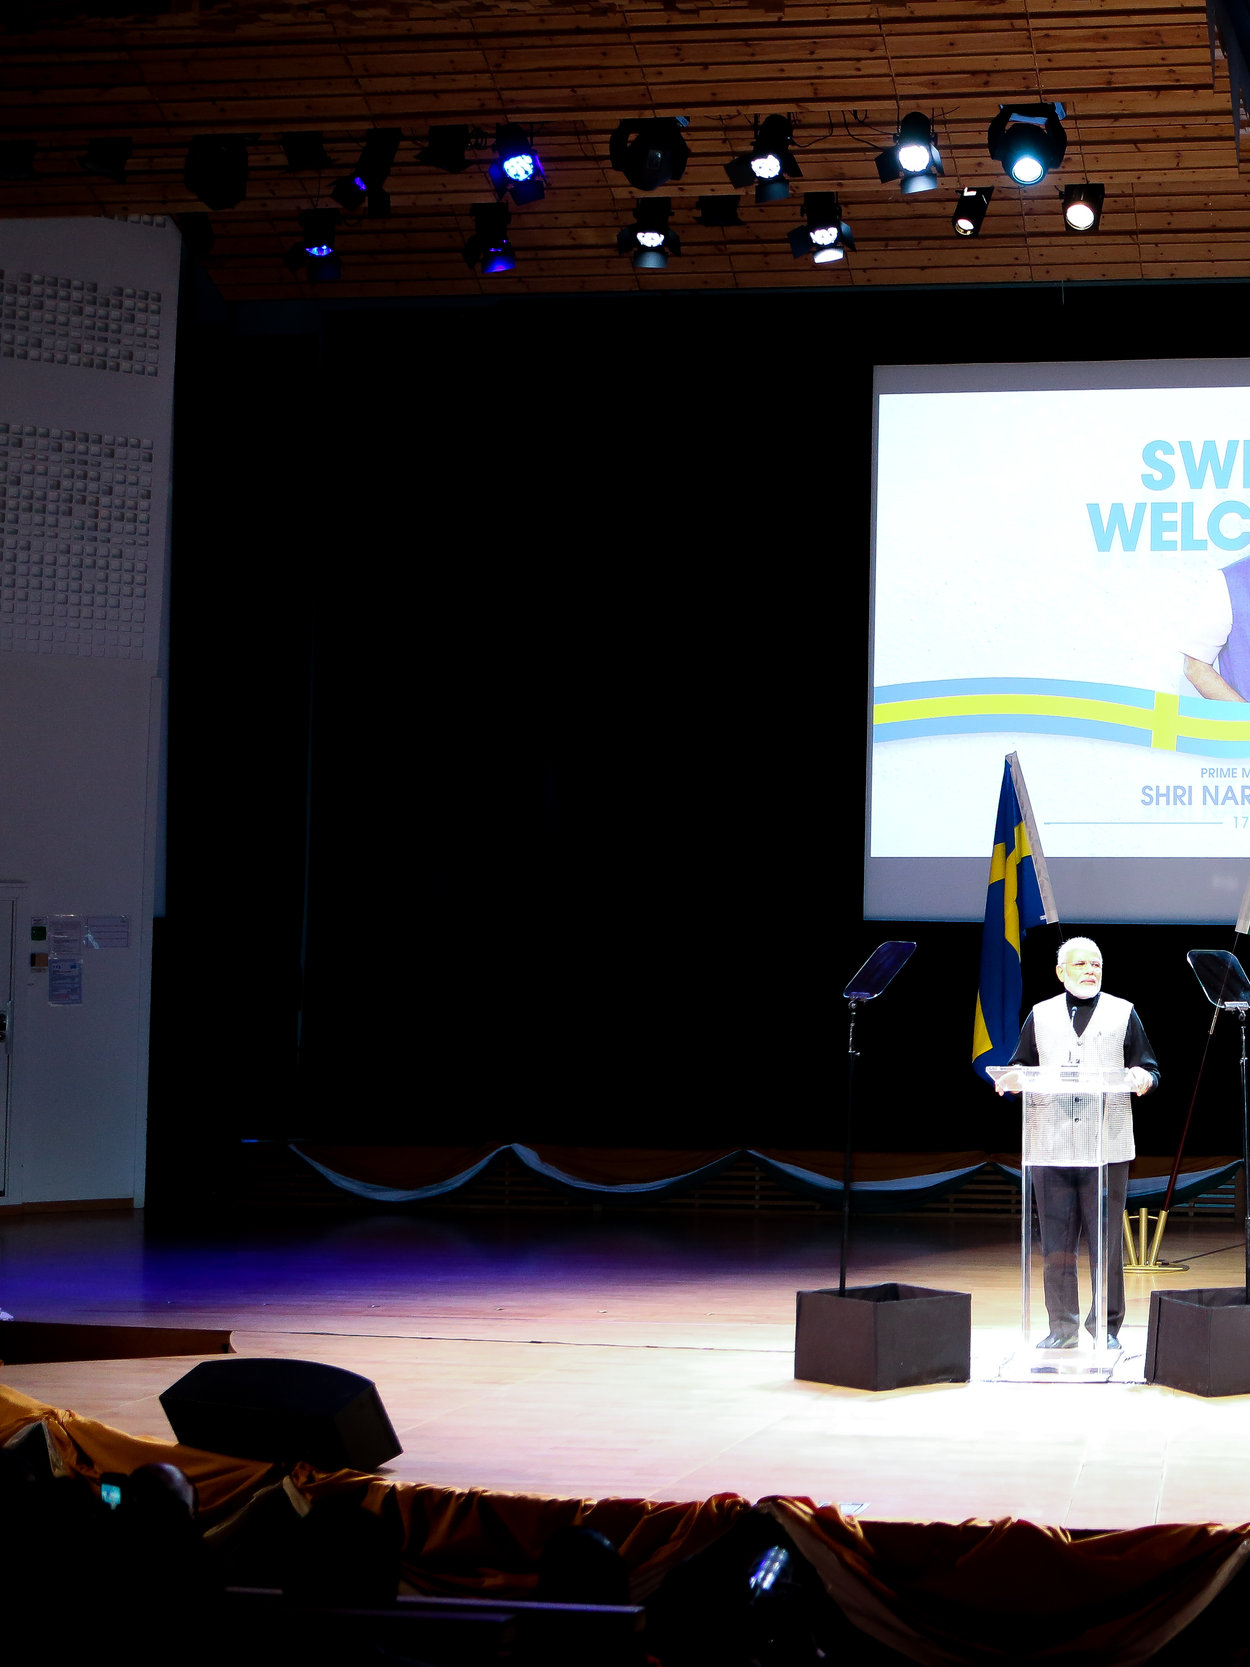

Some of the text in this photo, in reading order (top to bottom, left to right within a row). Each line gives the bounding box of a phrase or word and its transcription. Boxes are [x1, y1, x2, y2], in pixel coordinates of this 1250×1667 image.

[1200, 767, 1238, 779] PRIME
[1140, 784, 1193, 806] SHRI
[1233, 815, 1249, 829] 17
